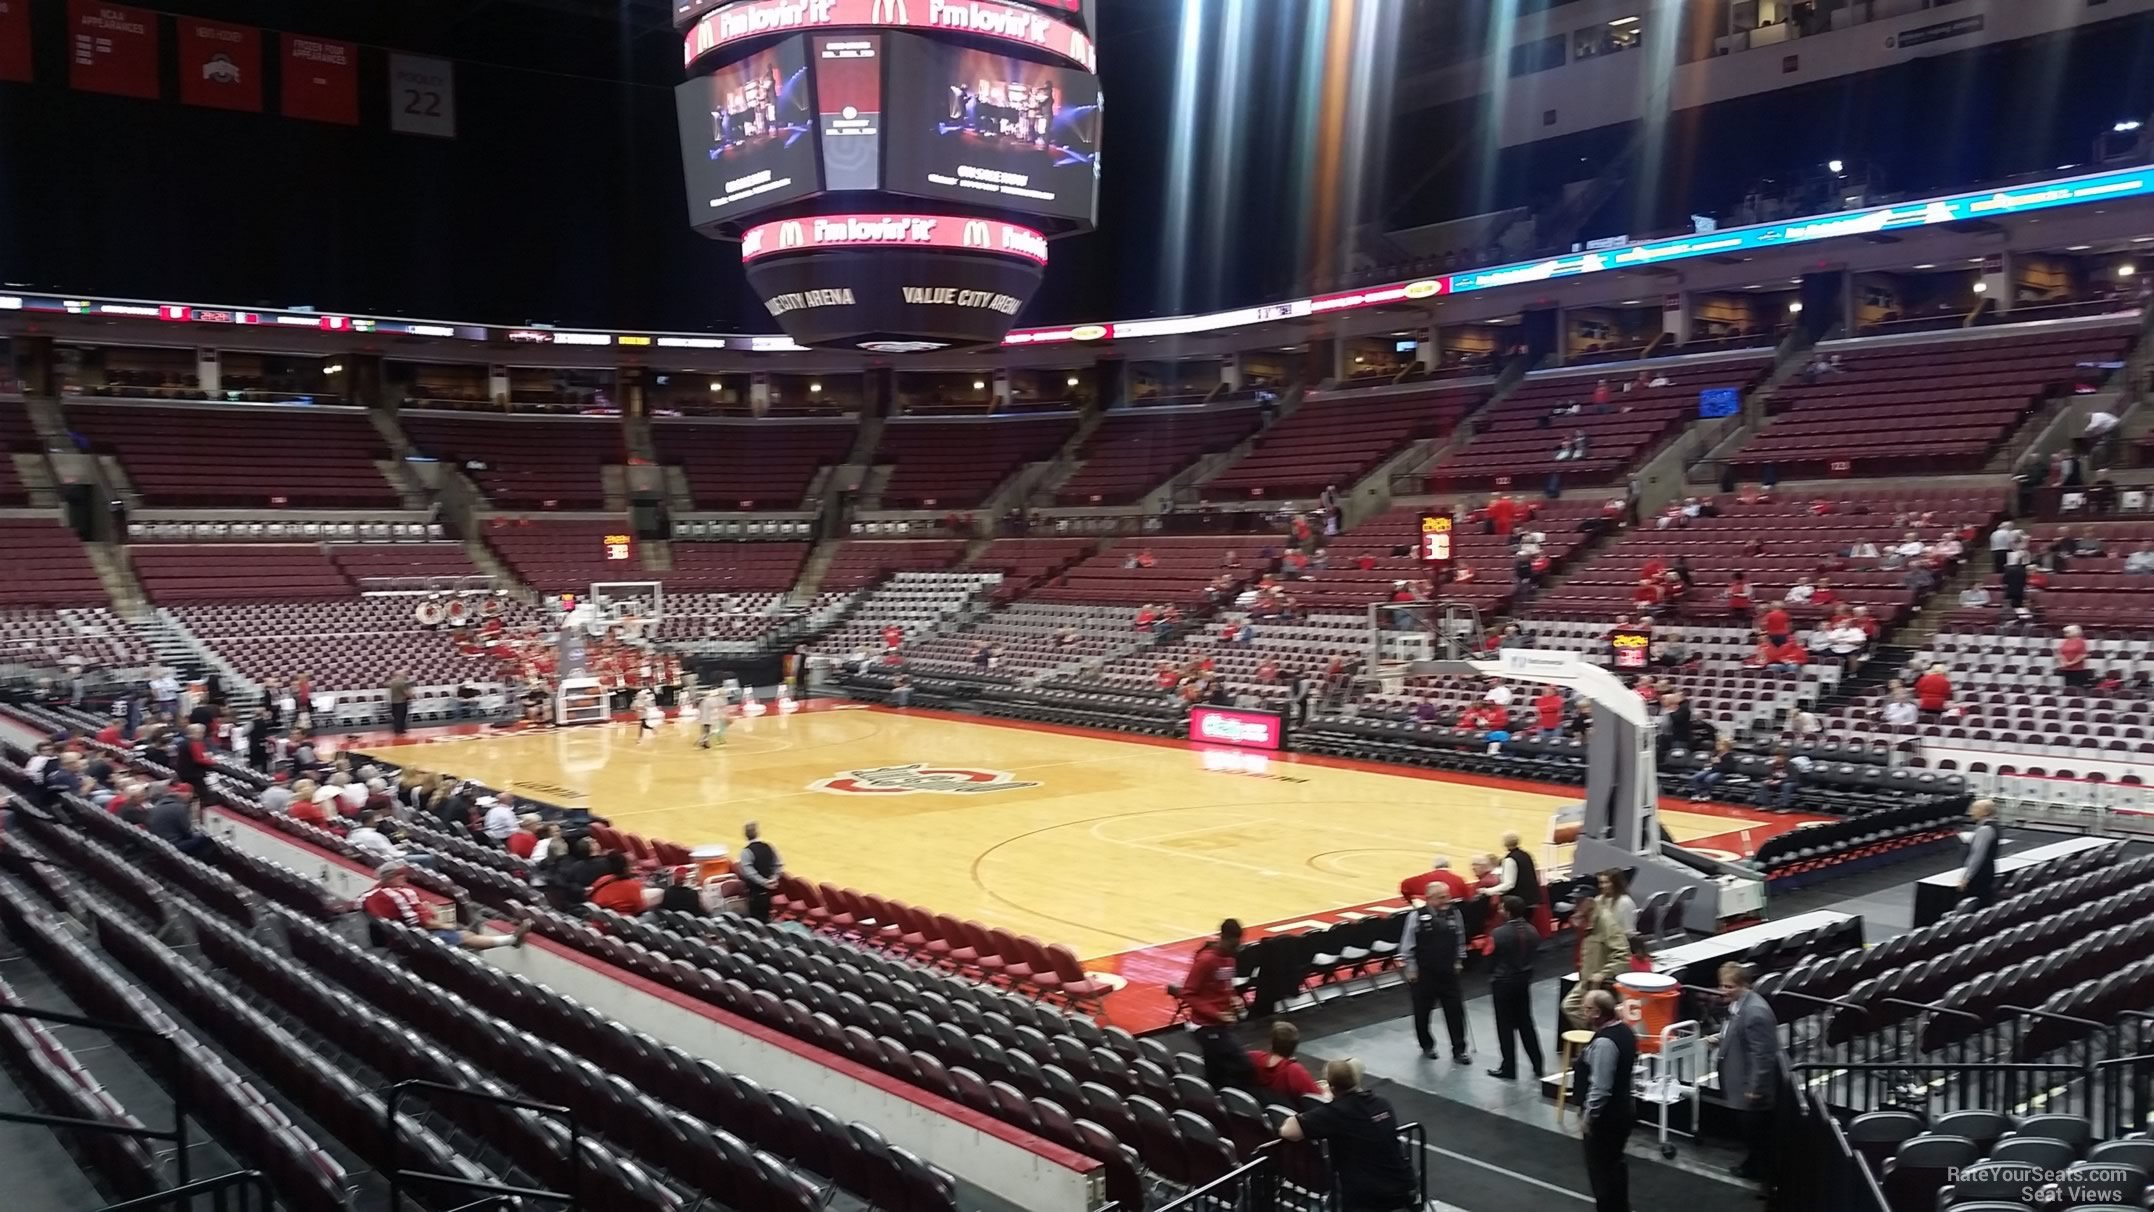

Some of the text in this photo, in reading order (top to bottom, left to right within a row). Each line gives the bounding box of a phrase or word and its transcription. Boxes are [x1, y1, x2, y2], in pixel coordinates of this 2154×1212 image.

[81, 15, 145, 34] APPEARANCES
[403, 88, 441, 118] 22
[805, 288, 856, 308] ARENA
[902, 286, 959, 304] VALUE
[957, 289, 996, 307] CITY
